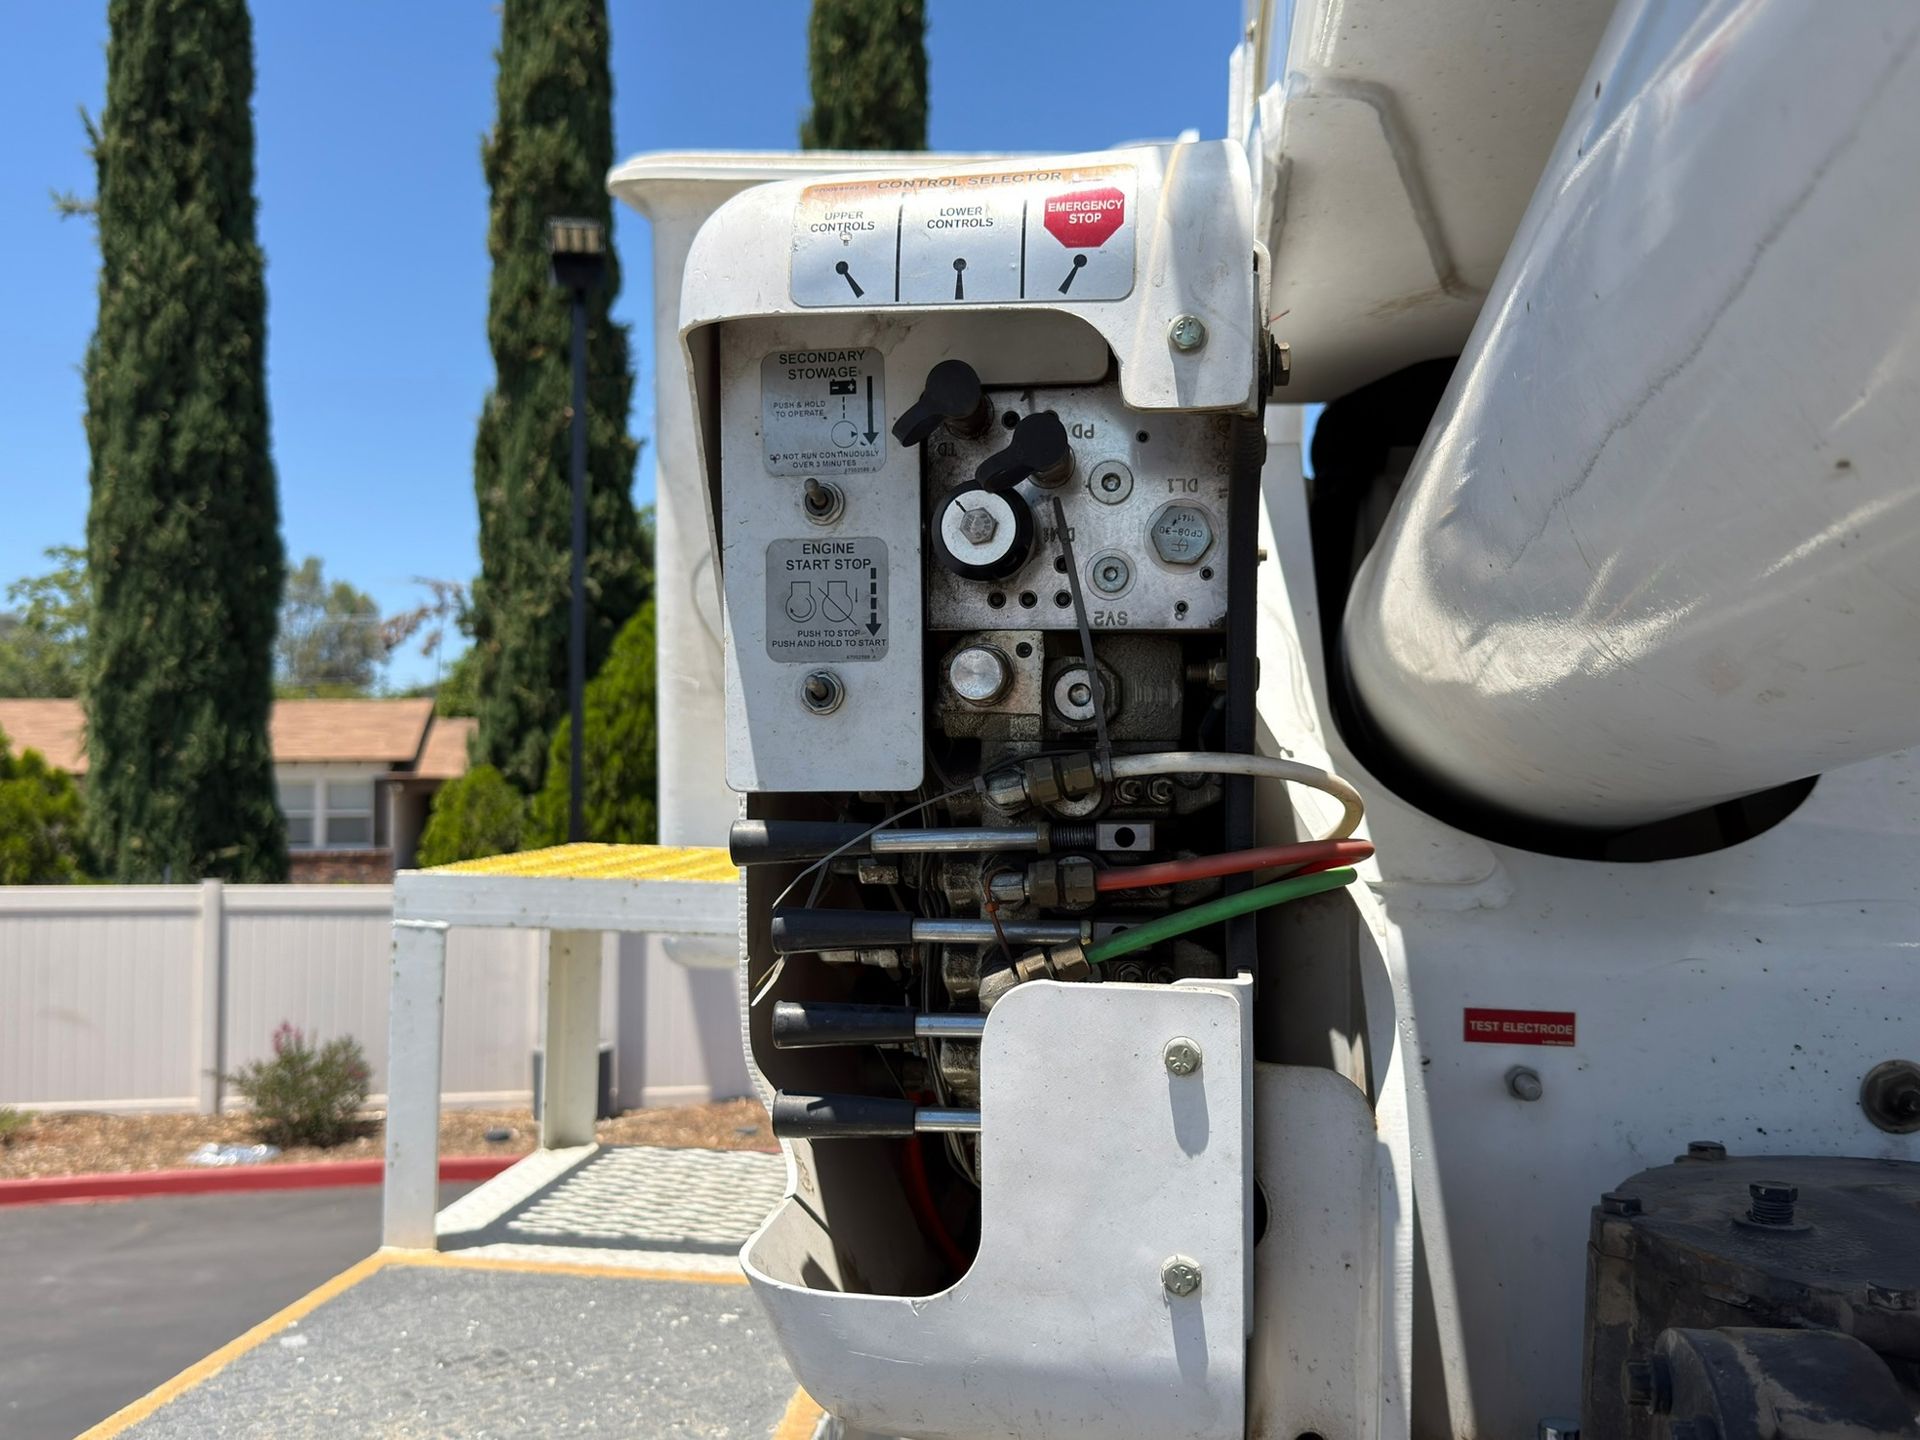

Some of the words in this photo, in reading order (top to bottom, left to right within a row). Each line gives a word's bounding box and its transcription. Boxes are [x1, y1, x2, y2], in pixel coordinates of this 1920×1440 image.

[877, 176, 960, 190] CONTROL
[967, 171, 1062, 186] SELECTOR
[940, 206, 983, 217] LOWER
[1047, 199, 1124, 213] EMERGENCY
[824, 210, 864, 220] UPPER
[1068, 213, 1102, 224] STOP
[810, 221, 875, 232] CONTROLS
[926, 217, 994, 229] CONTROLS
[779, 350, 865, 365] SECONDARY
[788, 366, 858, 380] STOWAGE
[773, 401, 795, 409] PUSH
[805, 400, 826, 408] HOLD
[788, 409, 825, 417] OPERATE
[1072, 423, 1095, 439] PD
[783, 452, 800, 460] NOT
[801, 451, 818, 459] RUN
[819, 450, 880, 459] CONTINUOUSLY
[792, 461, 814, 469] OVER
[823, 460, 857, 468] MINUTES
[1167, 478, 1198, 493] DL1
[802, 543, 855, 554] ENGINE
[786, 559, 830, 570] START
[834, 558, 871, 570] STOP
[1094, 611, 1128, 626] SV2
[837, 629, 860, 637] STOP
[772, 640, 795, 648] PUSH
[818, 639, 842, 647] HOLD
[845, 639, 856, 647] TO
[858, 639, 887, 647] START
[1469, 1020, 1500, 1032] TEST
[1502, 1022, 1573, 1035] ELECTRODE
